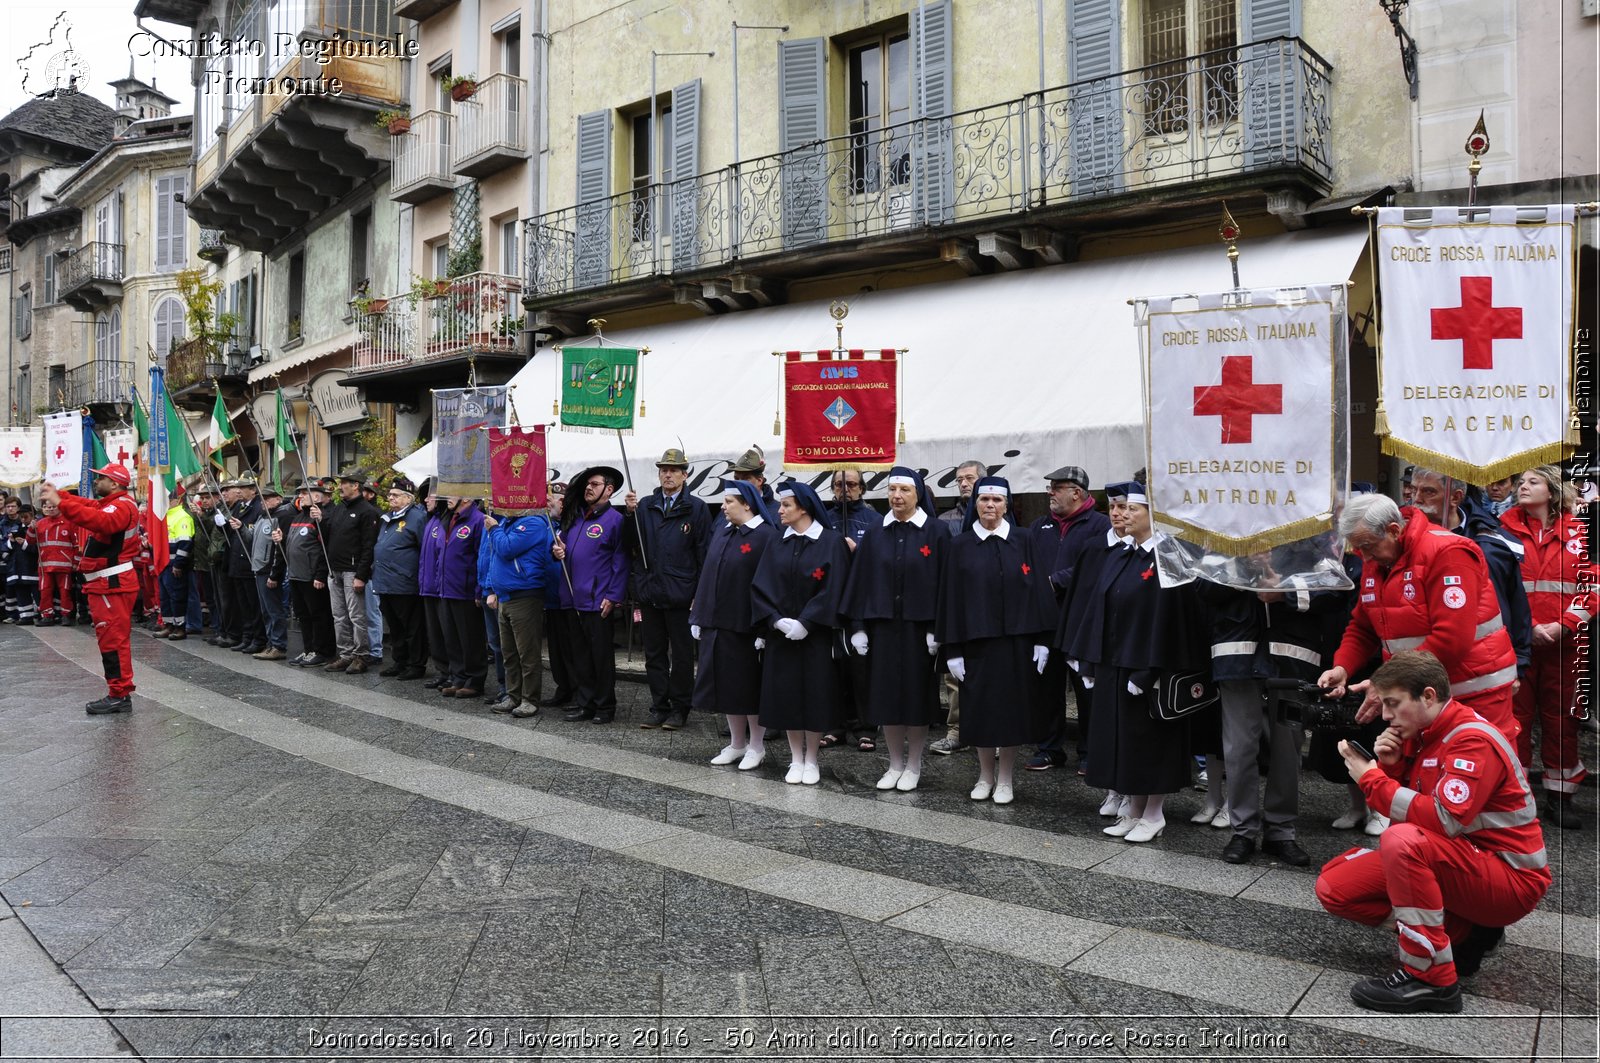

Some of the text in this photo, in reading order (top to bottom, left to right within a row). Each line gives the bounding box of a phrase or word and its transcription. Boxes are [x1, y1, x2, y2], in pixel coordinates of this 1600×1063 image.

[1391, 244, 1557, 262] CROCE ROSSA ITALIANA
[1163, 322, 1317, 347] CROCE ROSSA ITALIANA
[1404, 385, 1555, 400] DELEGAZIONE DI
[1423, 415, 1533, 432] BACENO
[797, 446, 885, 456] DOMODOSSOLA
[1168, 460, 1313, 475] DELEGAZIONE DI
[1183, 489, 1297, 505] ANTRONA
